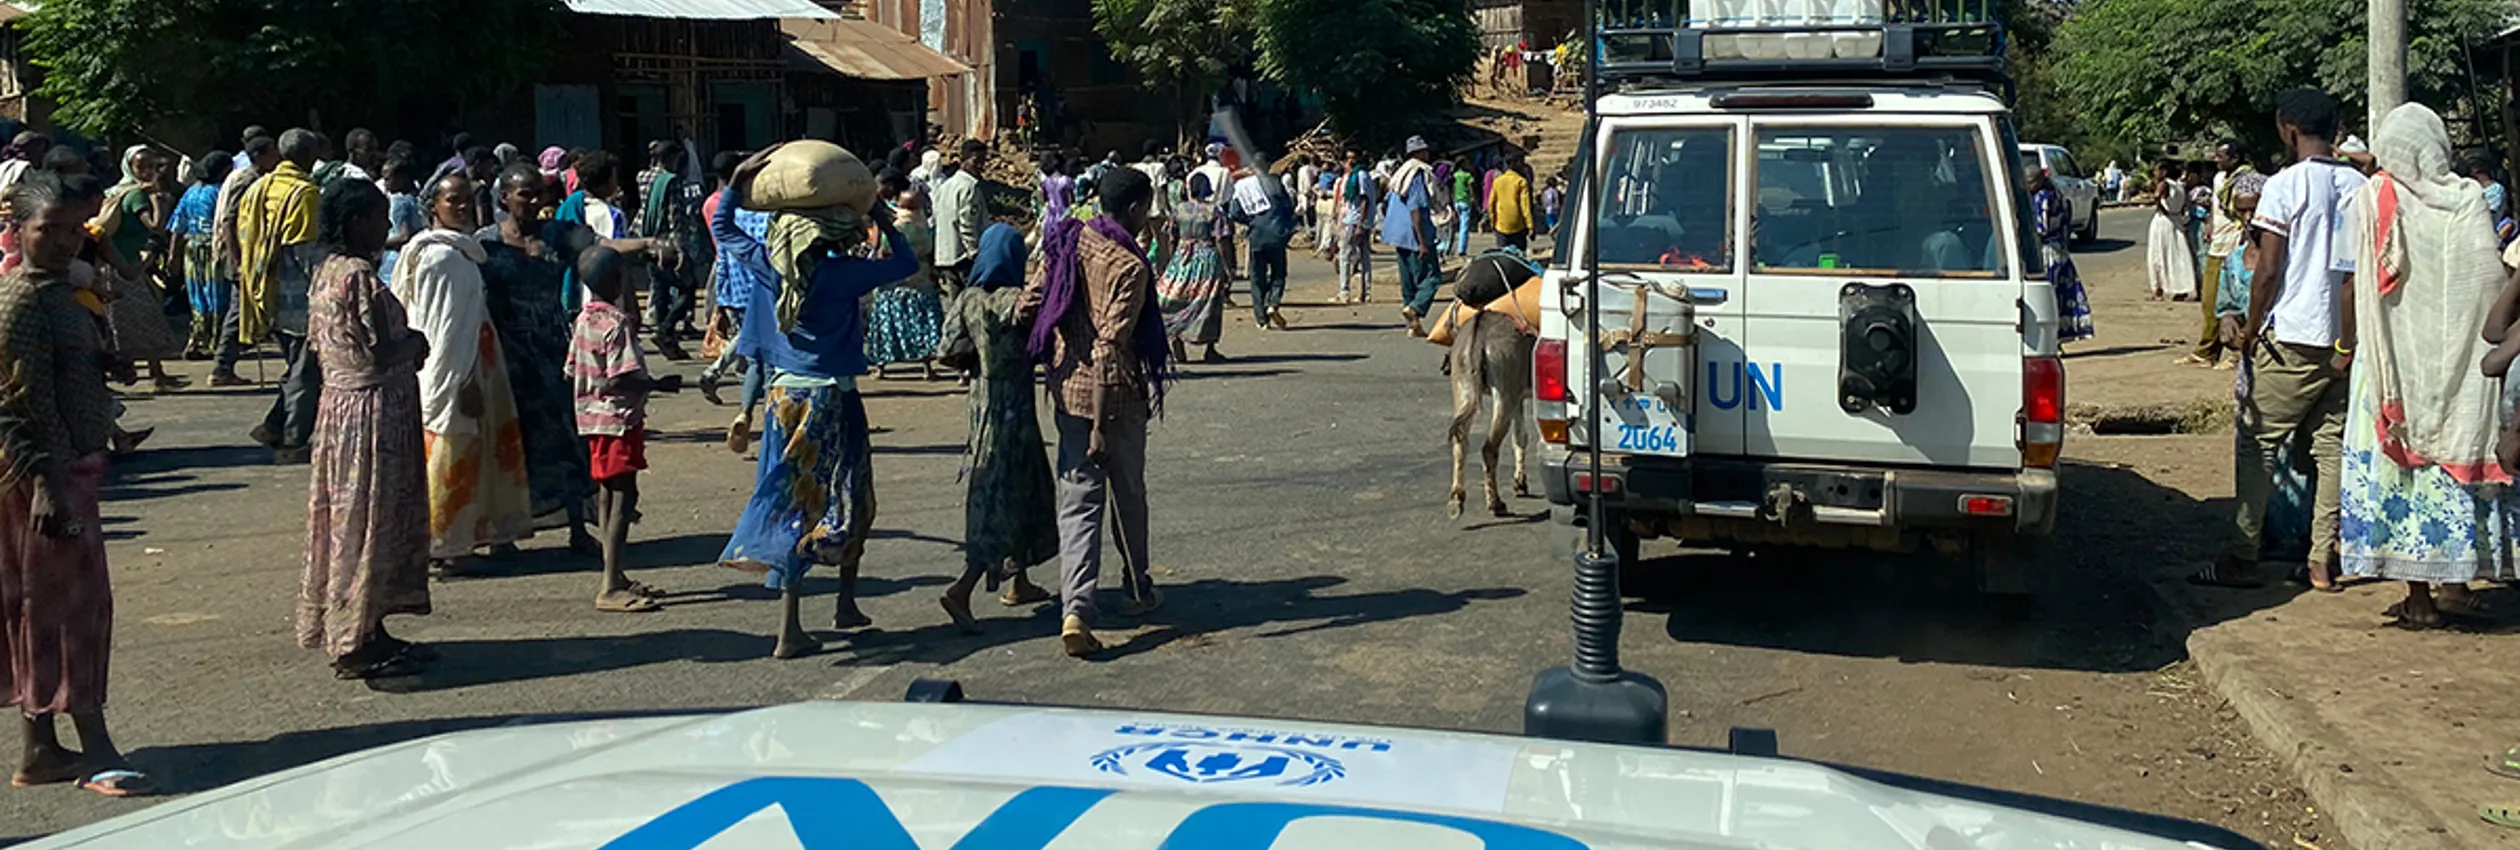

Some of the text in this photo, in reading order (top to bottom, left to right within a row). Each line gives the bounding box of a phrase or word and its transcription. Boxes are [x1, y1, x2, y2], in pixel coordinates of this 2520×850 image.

[1708, 361, 1782, 411] UN
[1618, 423, 1677, 453] 2064
[1114, 725, 1391, 752] UNHCR
